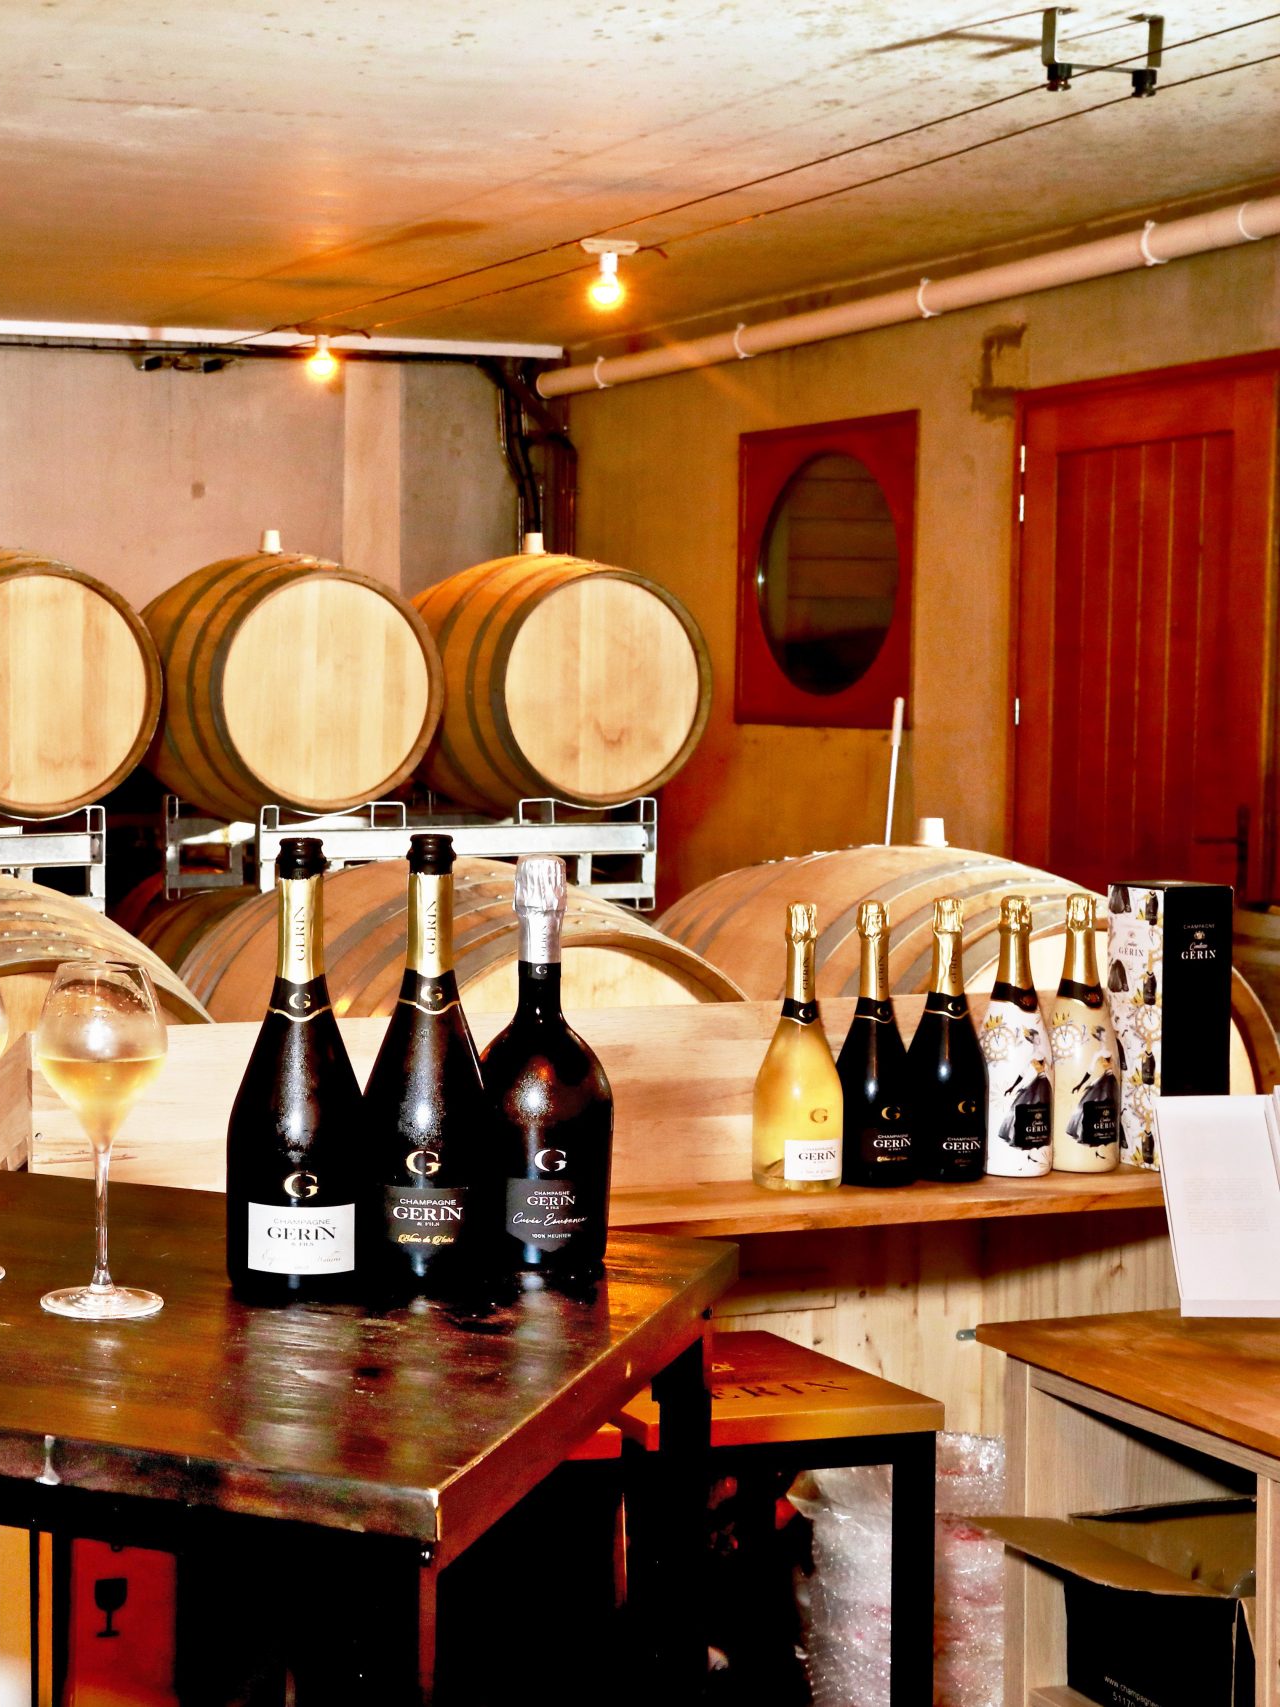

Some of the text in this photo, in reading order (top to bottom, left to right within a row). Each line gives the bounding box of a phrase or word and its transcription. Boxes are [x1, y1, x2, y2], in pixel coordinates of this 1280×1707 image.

[289, 992, 311, 1009] G
[420, 985, 443, 1002] G
[810, 1108, 829, 1124] G
[881, 1106, 901, 1120] G
[873, 1137, 912, 1148] GERIN
[942, 1140, 982, 1151] GERIN
[405, 1150, 442, 1175] G
[534, 1149, 568, 1172] G
[798, 1150, 836, 1160] GERIN
[284, 1173, 319, 1198] G
[400, 1198, 457, 1206] CHAMPAGNE
[526, 1195, 576, 1206] GERIN
[393, 1206, 463, 1221] GERIN
[274, 1218, 331, 1226] CHAMPAGNE
[267, 1226, 336, 1241] GERIN
[712, 1380, 848, 1399] ERIN
